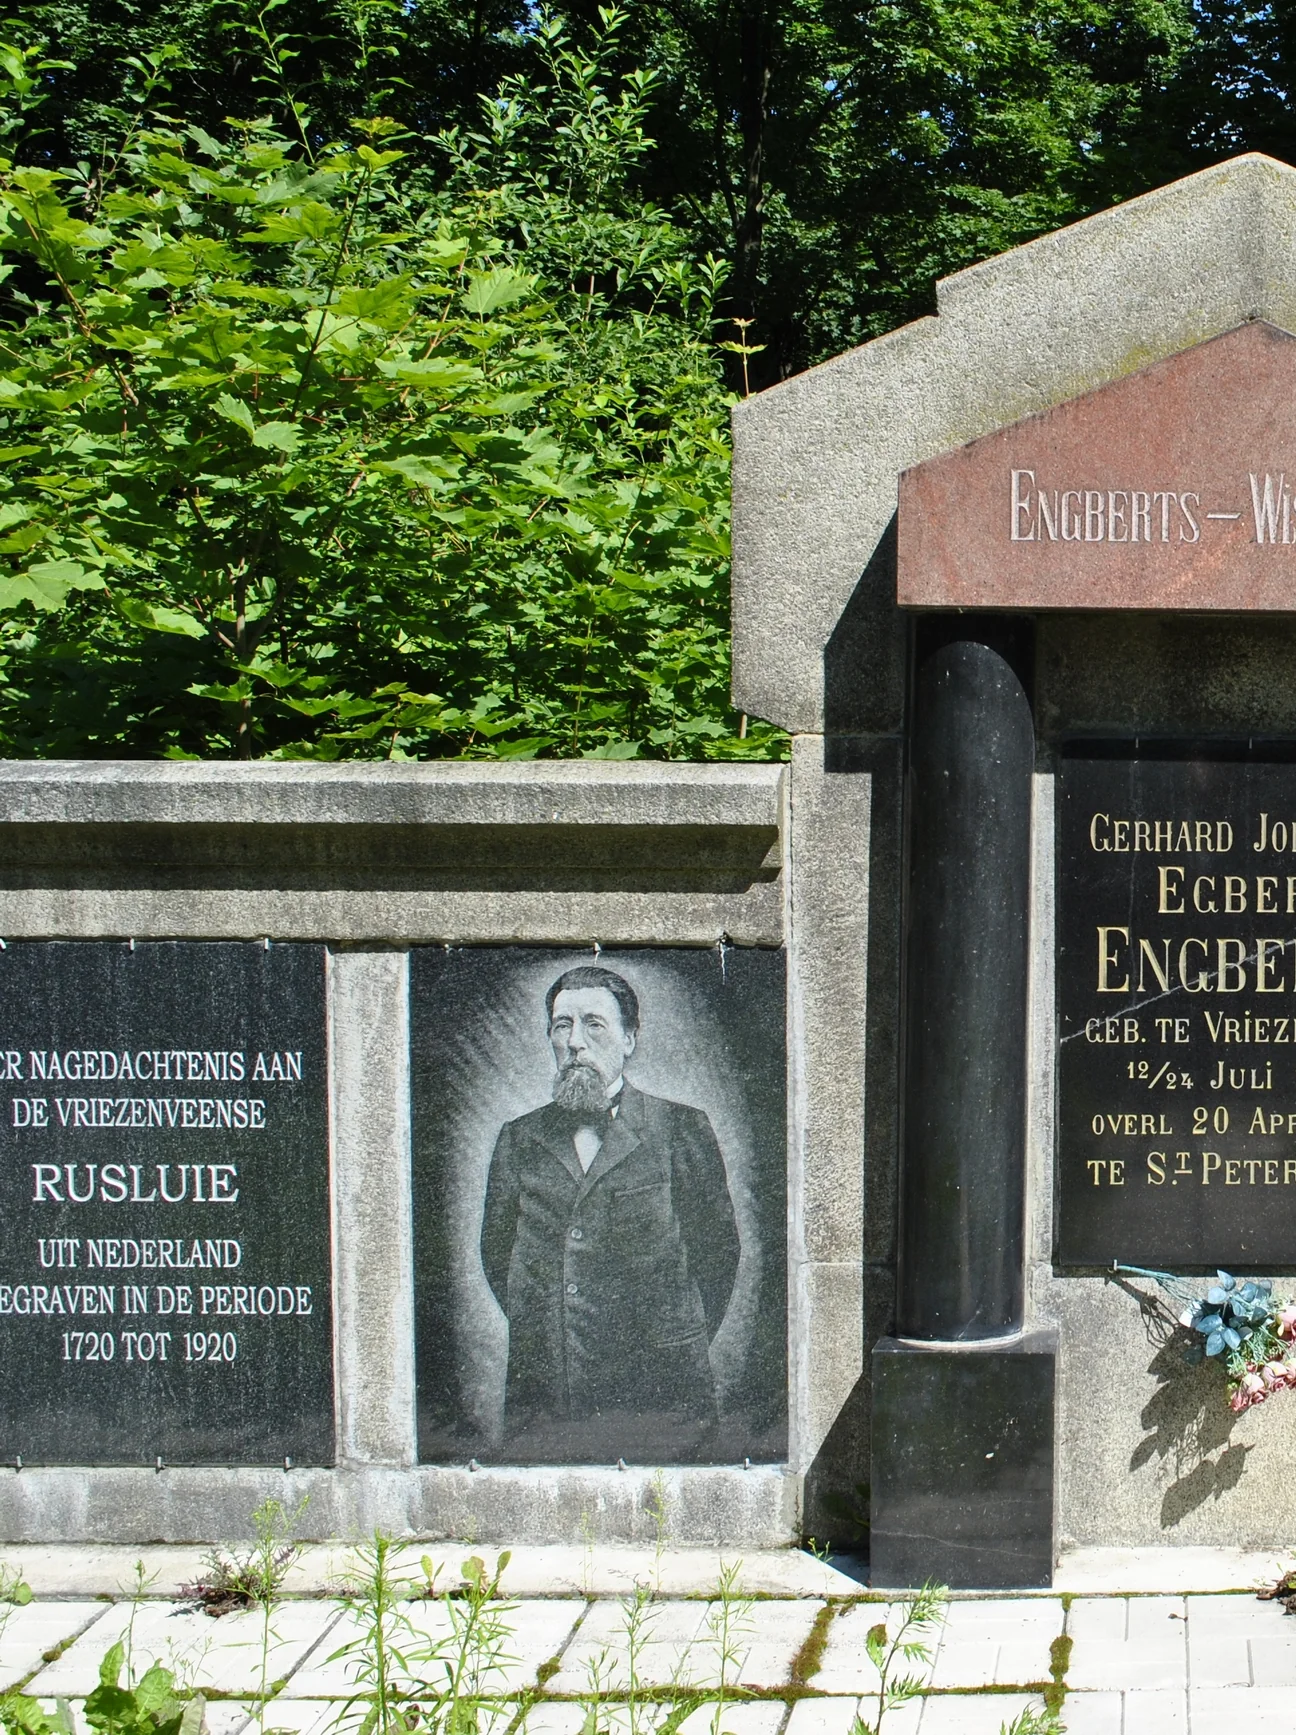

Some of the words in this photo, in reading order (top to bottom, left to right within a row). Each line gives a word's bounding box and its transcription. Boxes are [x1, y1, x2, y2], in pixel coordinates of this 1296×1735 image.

[1009, 468, 1200, 543] ENGBERTS
[1090, 812, 1233, 853] GERHARD
[1085, 1017, 1147, 1044] GEB.
[1155, 1018, 1190, 1043] TE
[29, 1050, 245, 1082] NAGEDACHTENIS
[251, 1051, 302, 1081] AAN
[1210, 1061, 1271, 1089] JULI
[12, 1098, 49, 1128] DE
[54, 1097, 266, 1129] VRIEZENVEENSE
[1092, 1114, 1173, 1135] OVERL
[1192, 1106, 1229, 1135] 20
[31, 1163, 239, 1203] RUSLUIE
[1087, 1160, 1125, 1185] TE
[37, 1237, 81, 1268] UIT
[86, 1238, 242, 1269] NEDERLAND
[122, 1285, 149, 1315] IN
[156, 1285, 193, 1315] DE
[199, 1285, 313, 1315] PERIODE
[62, 1331, 115, 1361] 1720
[120, 1331, 172, 1362] TOT
[183, 1331, 237, 1362] 1920
